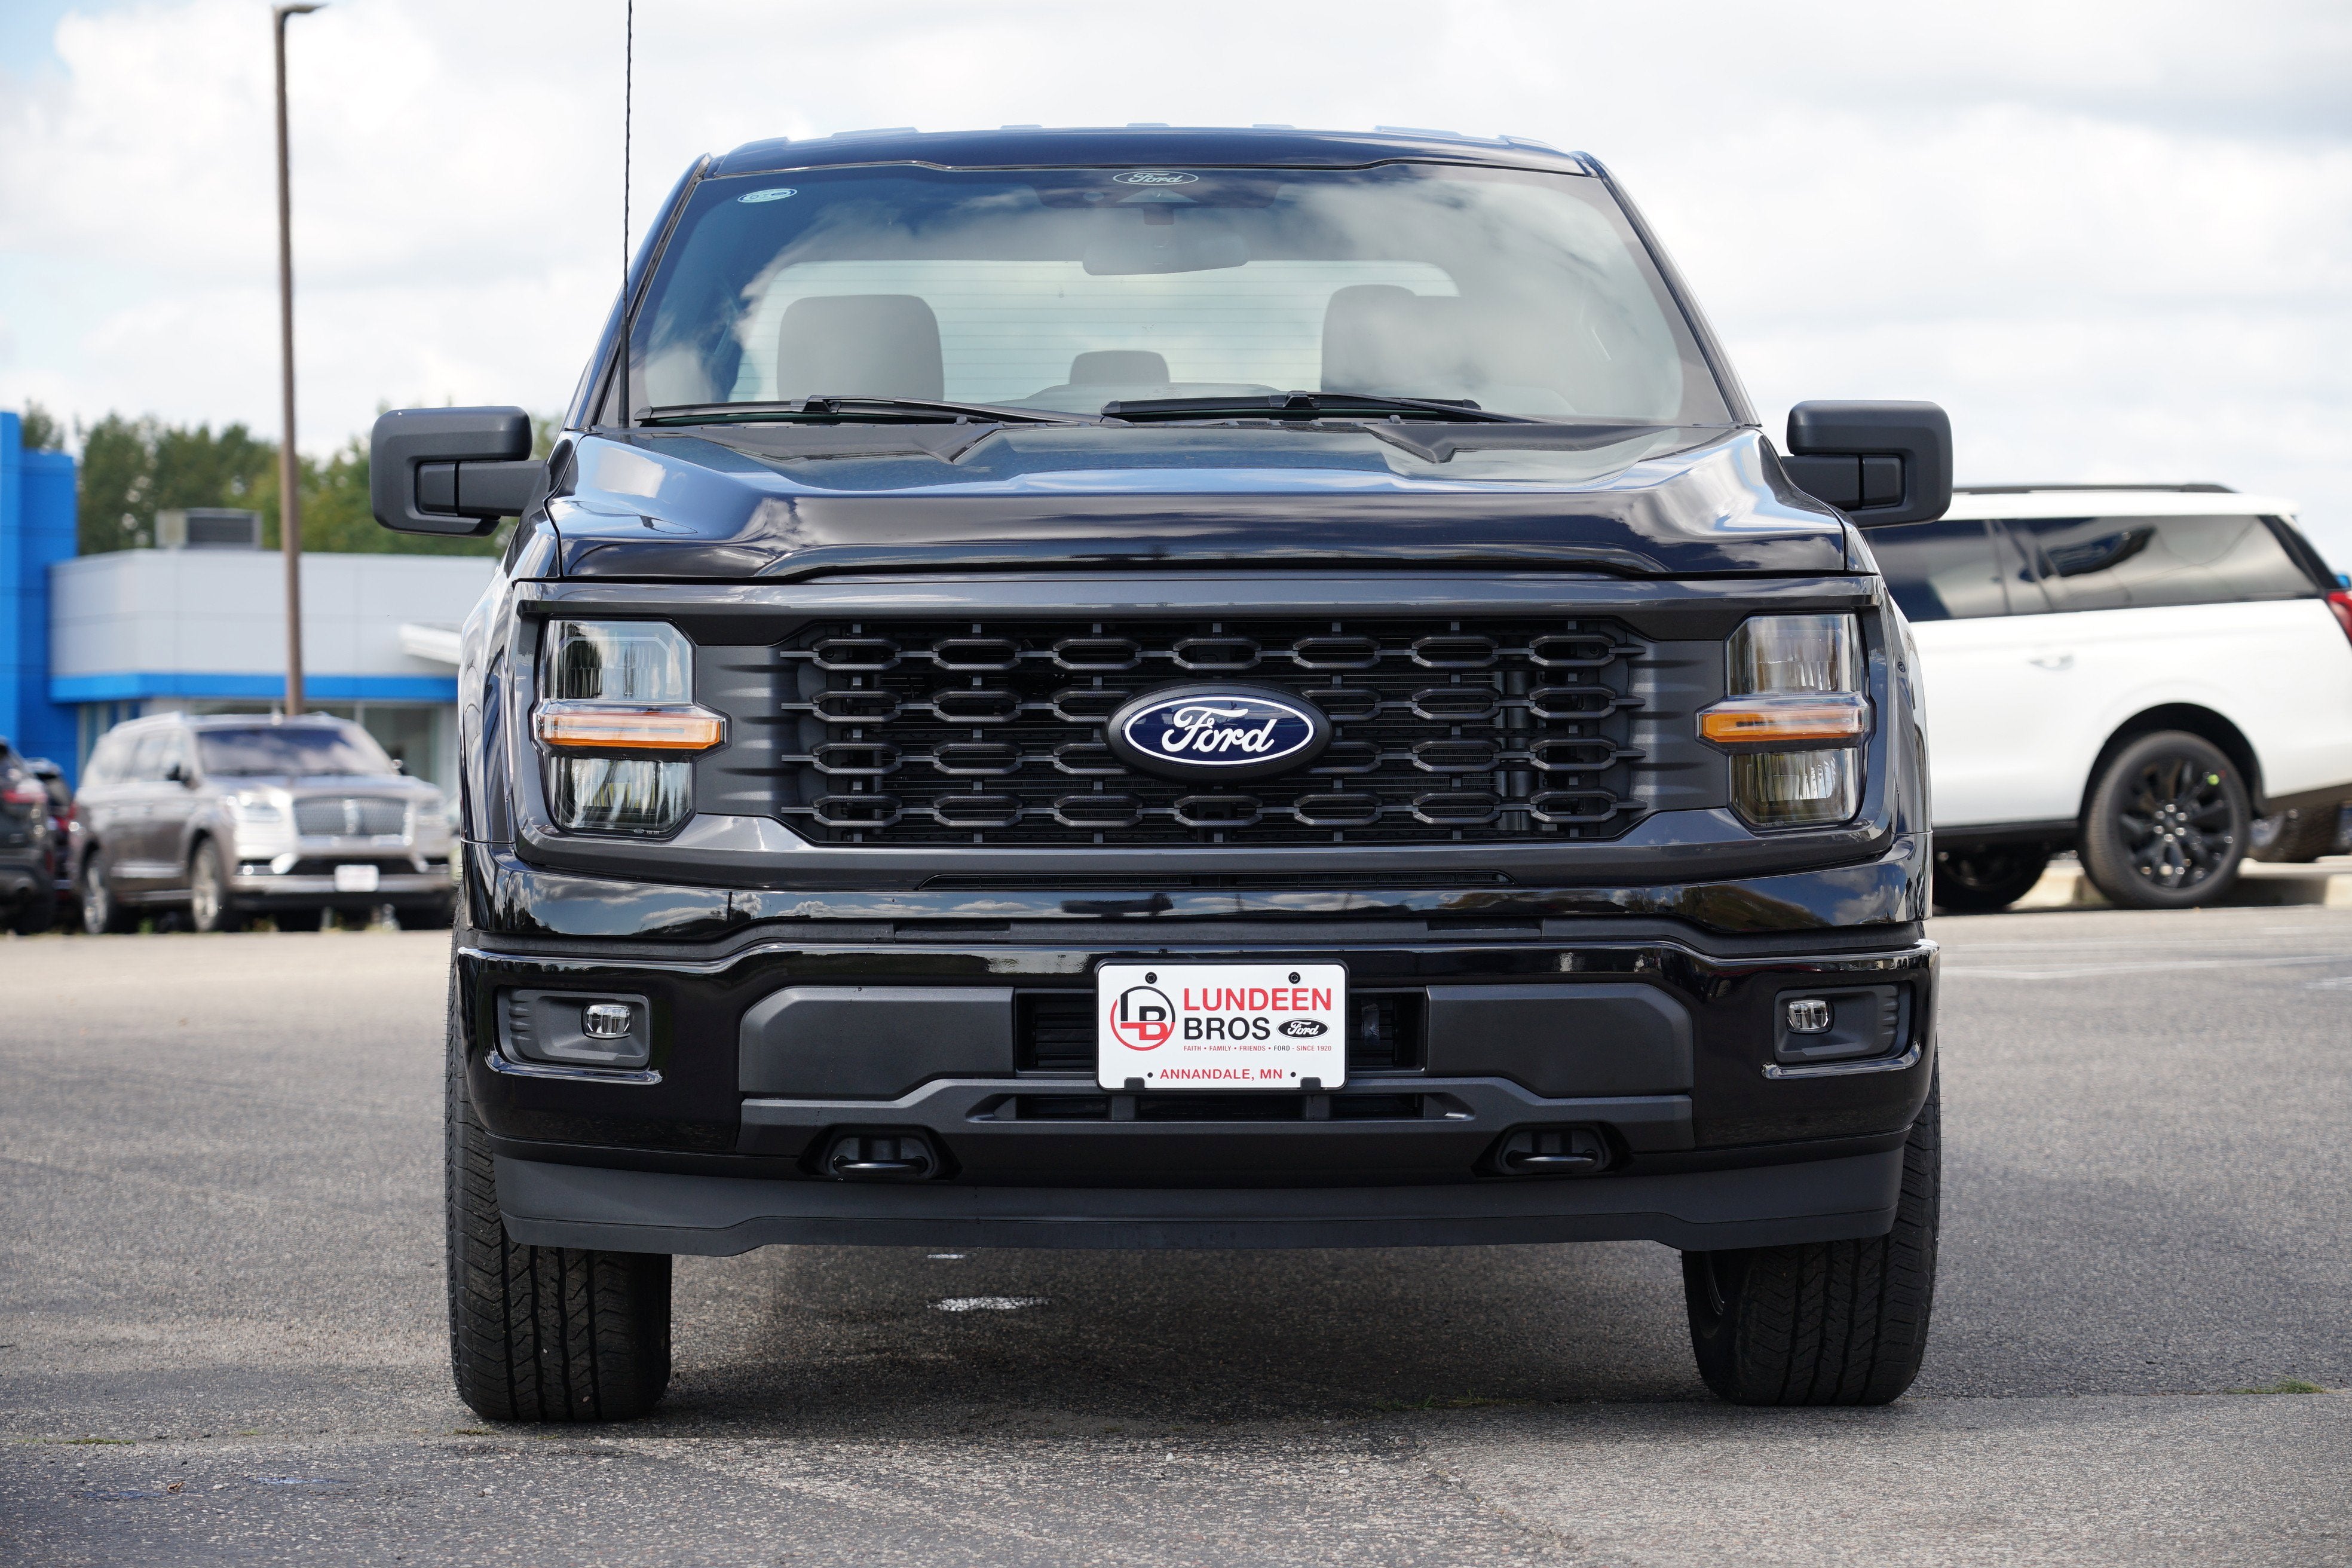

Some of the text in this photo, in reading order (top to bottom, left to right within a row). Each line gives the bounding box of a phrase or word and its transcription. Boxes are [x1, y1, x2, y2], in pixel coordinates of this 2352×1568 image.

[1128, 173, 1184, 183] Ford
[1162, 706, 1278, 752] Ford
[1184, 988, 1331, 1011] LUNDEEN
[1184, 1016, 1271, 1040] BROS
[1287, 1021, 1319, 1036] Ford
[1160, 1068, 1282, 1081] ANNANDALE, MN
